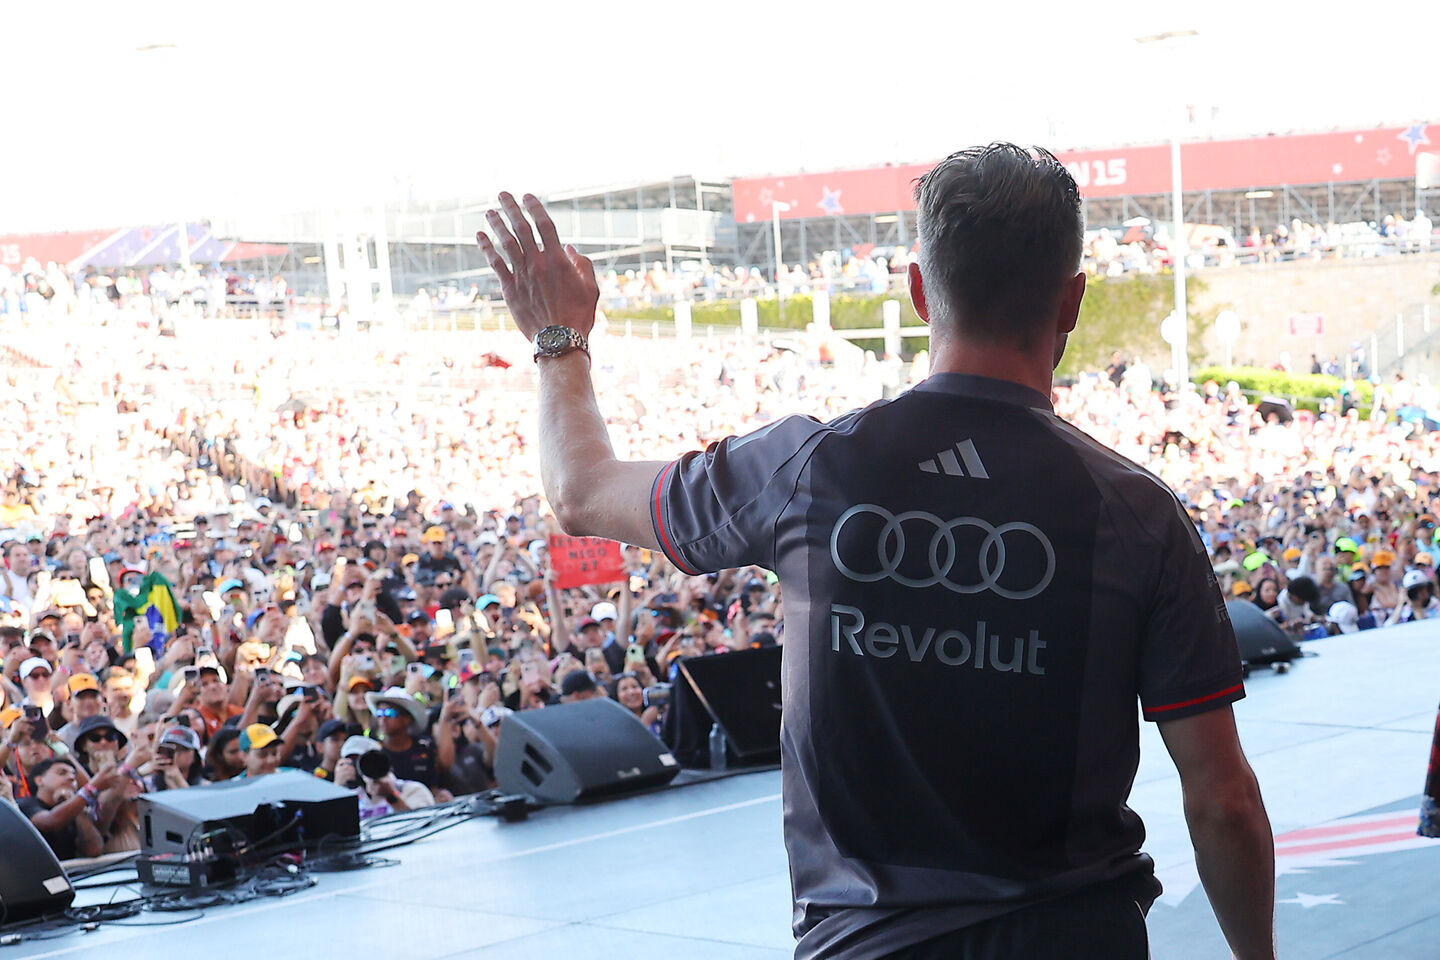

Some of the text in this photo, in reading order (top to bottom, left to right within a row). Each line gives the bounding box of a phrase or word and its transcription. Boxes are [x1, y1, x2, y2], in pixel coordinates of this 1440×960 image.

[1092, 158, 1127, 187] 15
[568, 547, 607, 559] NICO
[830, 603, 1048, 676] Revolut
